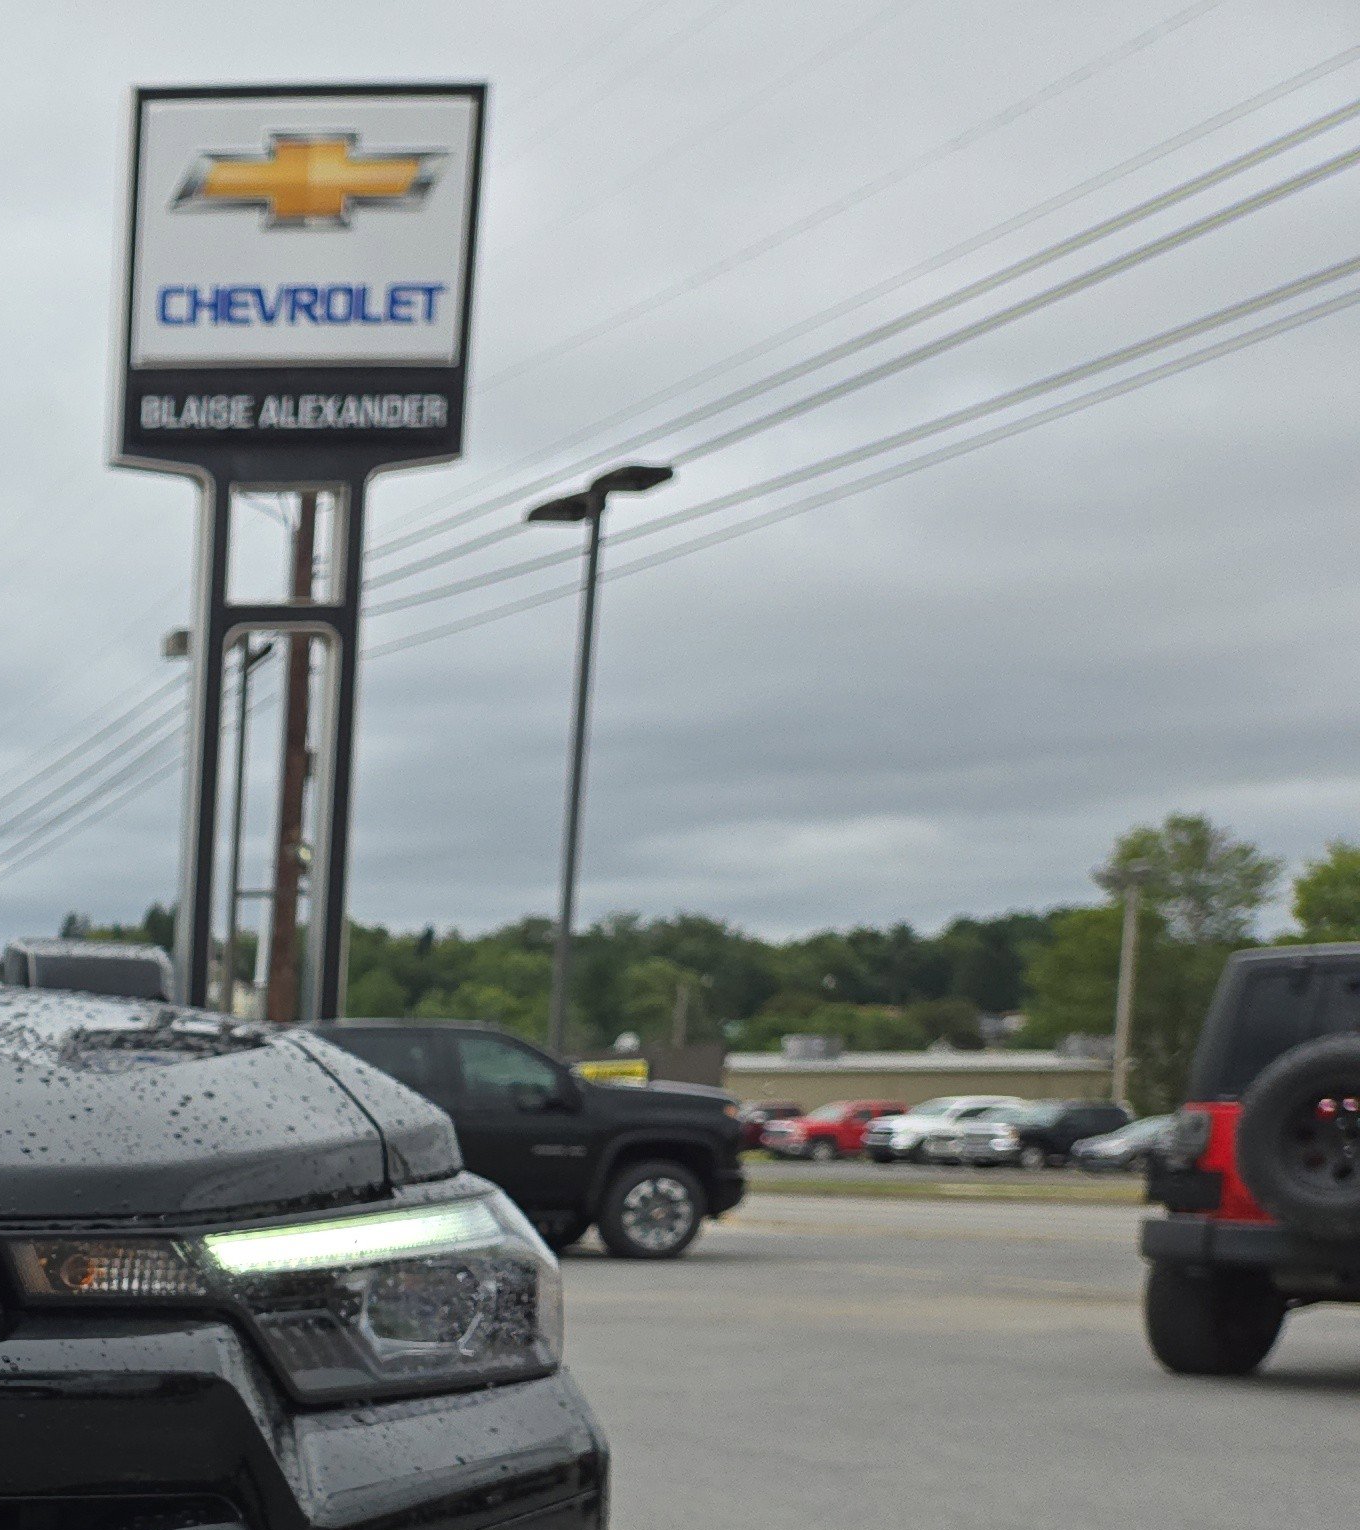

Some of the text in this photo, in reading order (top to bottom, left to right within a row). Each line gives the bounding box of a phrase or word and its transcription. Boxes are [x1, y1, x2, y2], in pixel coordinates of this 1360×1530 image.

[156, 282, 447, 326] CHEVROLET
[140, 394, 449, 430] BLAISE ALEXANDER
